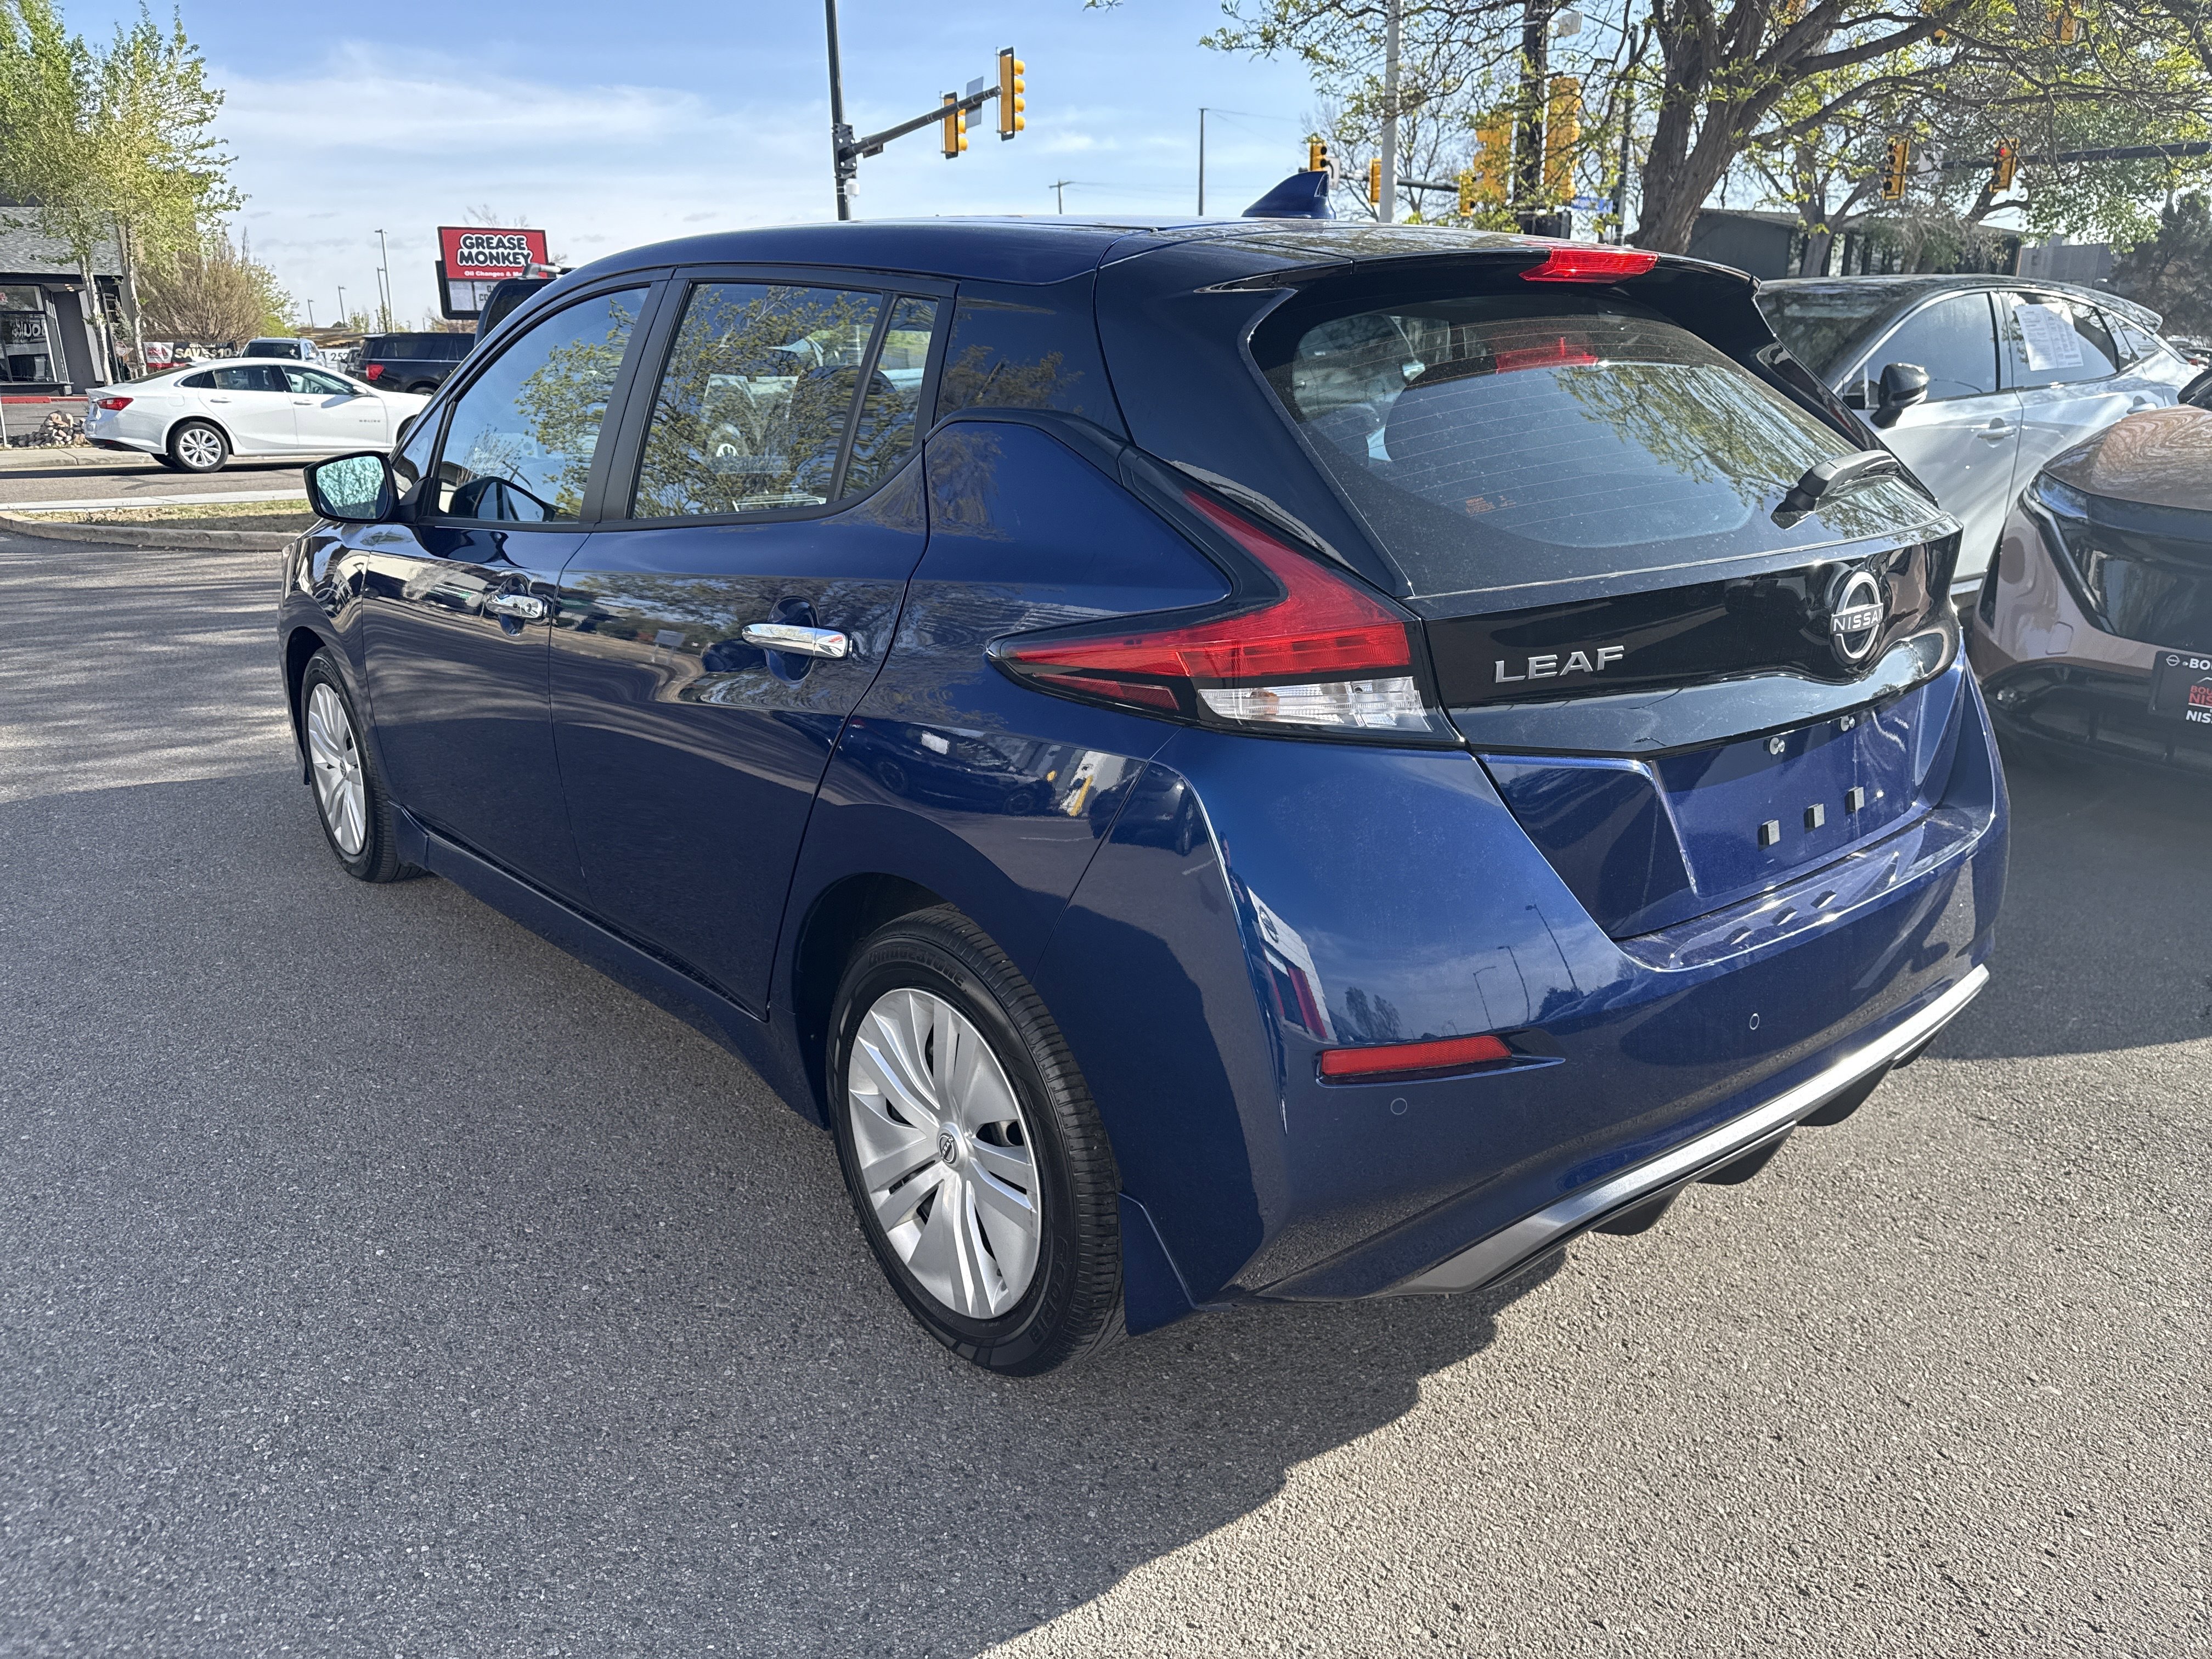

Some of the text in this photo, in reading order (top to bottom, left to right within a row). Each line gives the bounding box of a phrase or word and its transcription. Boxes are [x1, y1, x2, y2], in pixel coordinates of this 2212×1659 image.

[462, 235, 526, 251] GREASE
[459, 251, 531, 265] MONKEY
[1833, 608, 1883, 631] NISSAN
[1494, 645, 1624, 683] LEAF
[2189, 658, 2212, 670] BO
[2185, 710, 2212, 724] NIS
